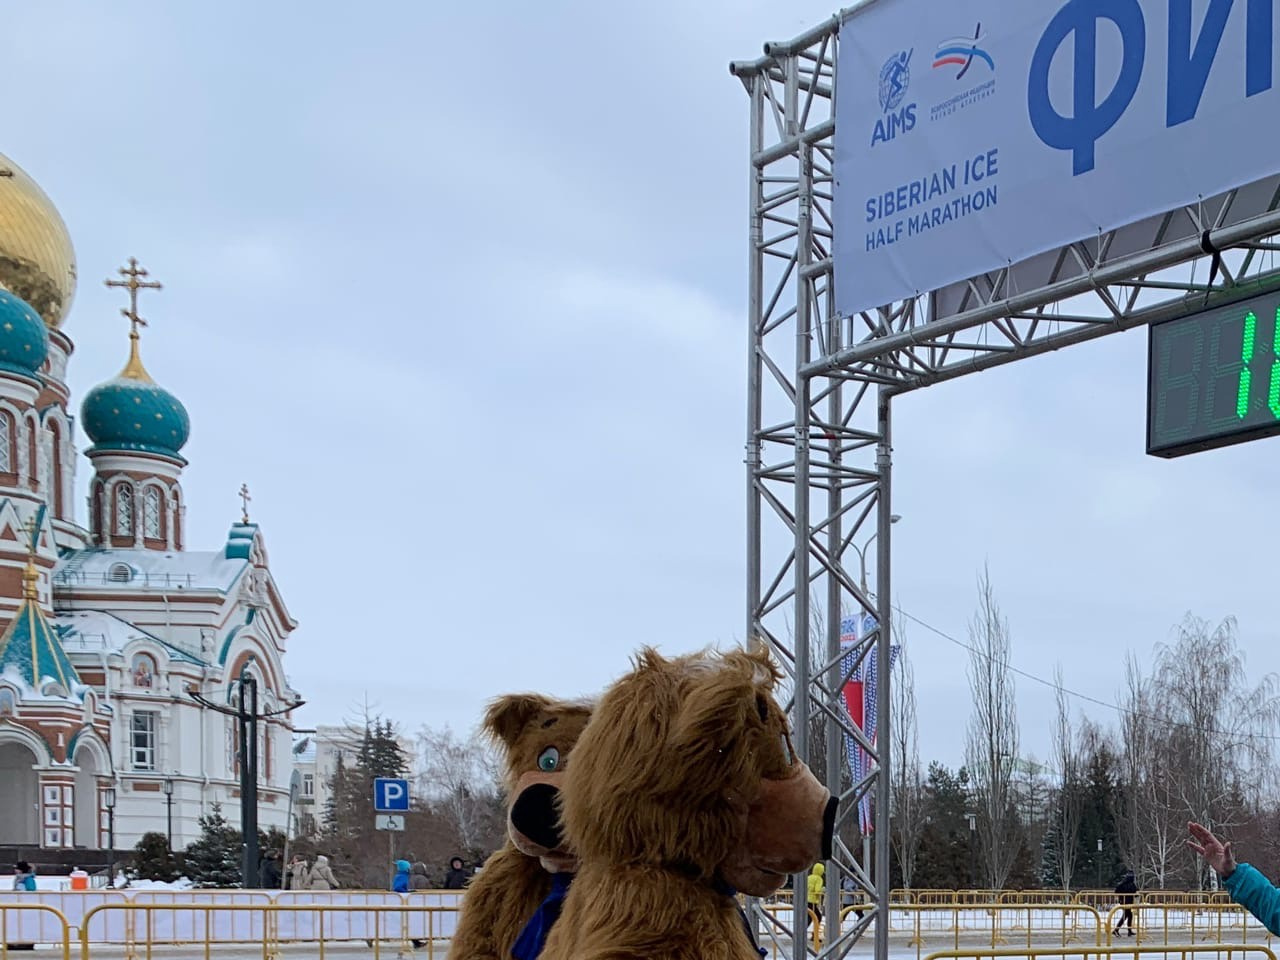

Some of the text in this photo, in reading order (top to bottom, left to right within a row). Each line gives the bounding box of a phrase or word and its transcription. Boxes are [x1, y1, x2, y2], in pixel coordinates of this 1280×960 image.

[871, 103, 917, 147] AIMS
[866, 148, 998, 222] SIBERIAN ICE
[866, 185, 997, 252] HALF MARATHON
[384, 783, 404, 808] P
